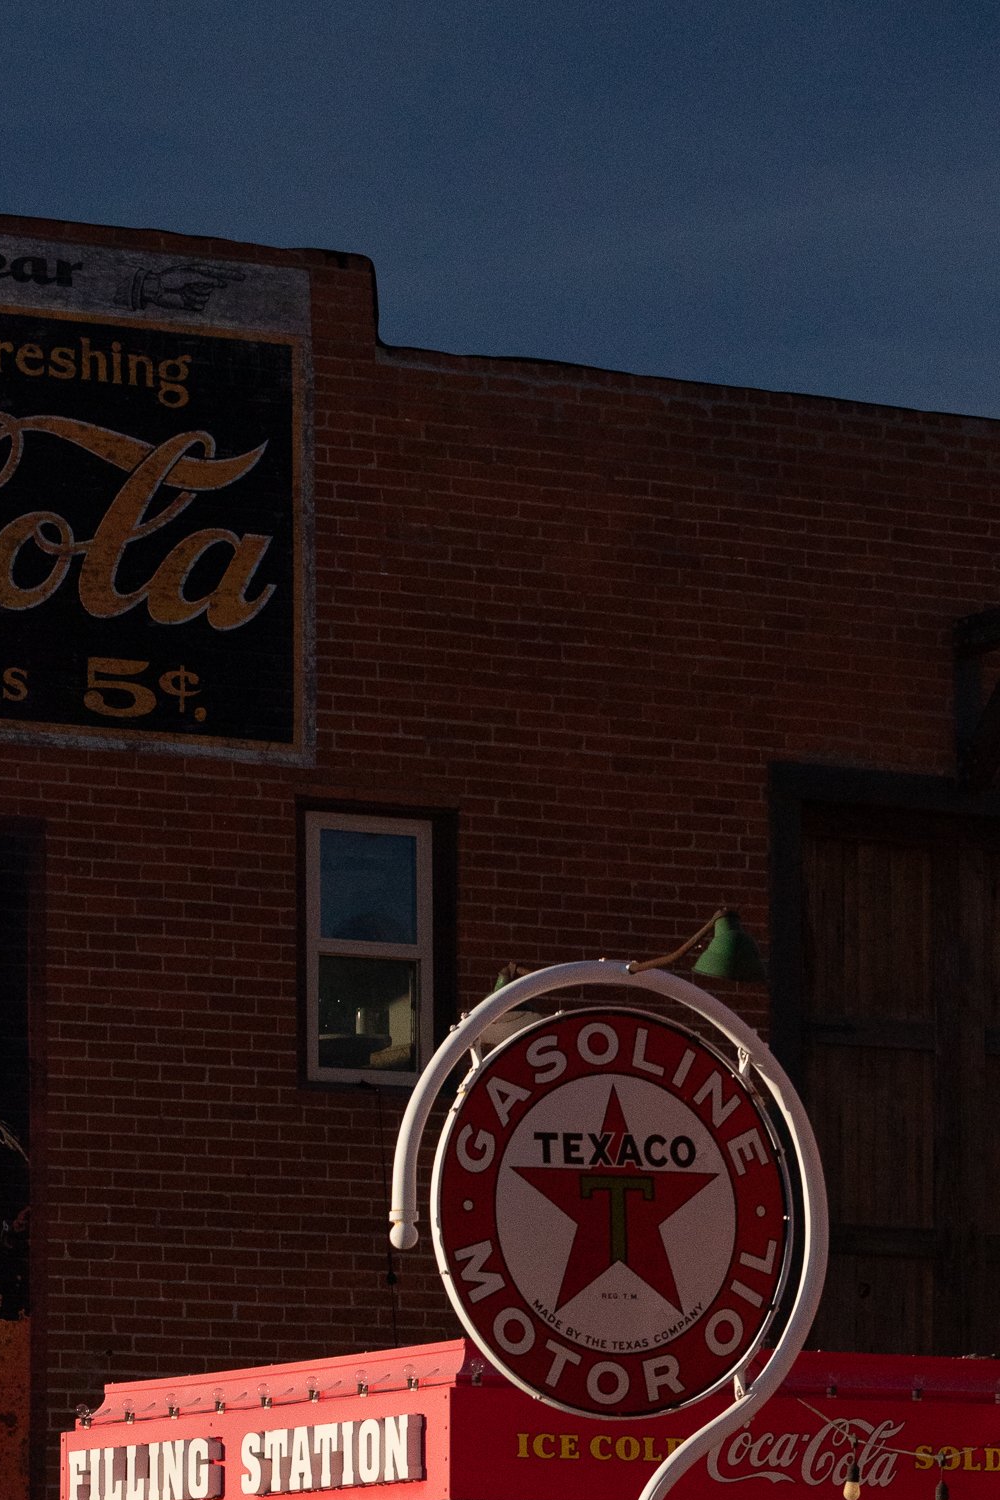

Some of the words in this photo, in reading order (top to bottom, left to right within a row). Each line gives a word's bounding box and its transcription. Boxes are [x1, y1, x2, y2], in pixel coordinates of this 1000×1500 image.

[455, 1021, 770, 1176] GASOLINE
[533, 1131, 697, 1169] TEXACO
[580, 1174, 655, 1264] T
[454, 1239, 686, 1406] MOTOR
[704, 1238, 779, 1357] OIL
[532, 1299, 563, 1330] MADE
[565, 1326, 582, 1340] BY
[584, 1334, 608, 1349] THE
[612, 1338, 649, 1350] TEXAS
[653, 1302, 704, 1344] COMPANY
[240, 1413, 412, 1497] STATION
[516, 1433, 581, 1462] ICE
